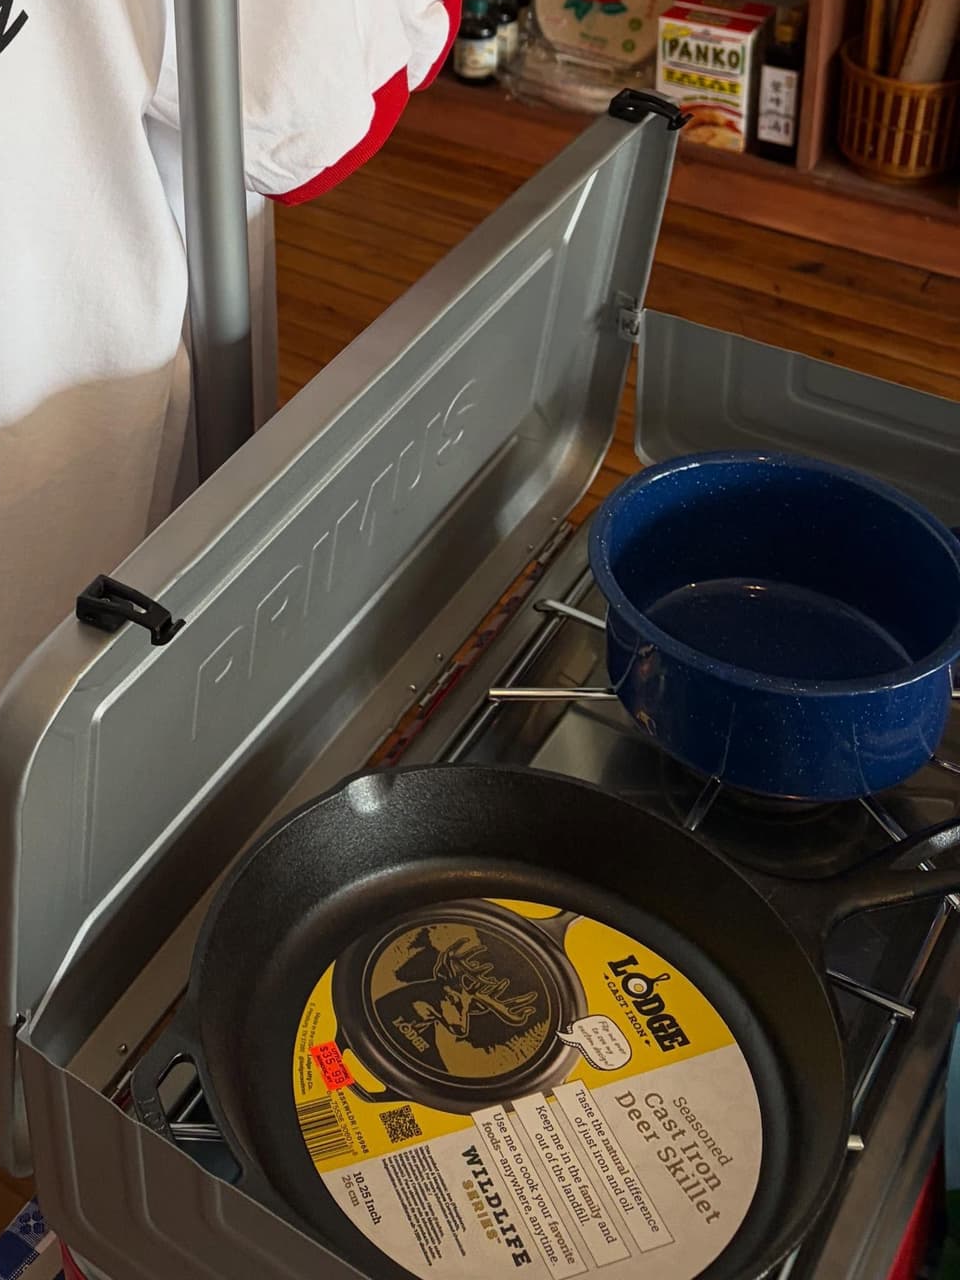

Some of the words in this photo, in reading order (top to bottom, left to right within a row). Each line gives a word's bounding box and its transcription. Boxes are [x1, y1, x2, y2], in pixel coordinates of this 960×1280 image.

[668, 38, 741, 68] PANKO
[607, 954, 691, 1052] LODGE
[607, 981, 629, 1008] CAST
[625, 1010, 648, 1038] IRON
[534, 1132, 550, 1151] out
[574, 1116, 588, 1128] of
[577, 1128, 598, 1150] just
[644, 1092, 687, 1142] Cast
[679, 1140, 722, 1192] Iron
[672, 1096, 734, 1167] Seasoned
[535, 1104, 555, 1132] Keep
[550, 1132, 565, 1151] me
[559, 1151, 572, 1165] in
[567, 1164, 583, 1184] the
[578, 1184, 603, 1219] family
[597, 1221, 618, 1244] and
[544, 1151, 559, 1164] of
[551, 1164, 566, 1183] the
[575, 1088, 595, 1119] Taste
[591, 1118, 606, 1137] the
[601, 1137, 631, 1177] natural
[623, 1176, 660, 1233] difference
[592, 1149, 610, 1174] iron
[614, 1090, 661, 1143] Deer
[656, 1145, 721, 1225] Skillet
[341, 1174, 355, 1190] 26
[348, 1189, 360, 1207] cm
[352, 1171, 372, 1199] 10.25
[364, 1198, 382, 1226] Inch
[461, 1145, 532, 1267] WILDLIFE
[493, 1112, 508, 1134] Use
[503, 1134, 518, 1152] me
[513, 1152, 524, 1165] to
[519, 1165, 539, 1193] cook
[531, 1193, 553, 1219] your
[548, 1220, 576, 1265] favorite
[561, 1183, 591, 1227] landfill.
[605, 1174, 626, 1196] and
[618, 1196, 635, 1215] oil.
[529, 1215, 559, 1267] anytime.
